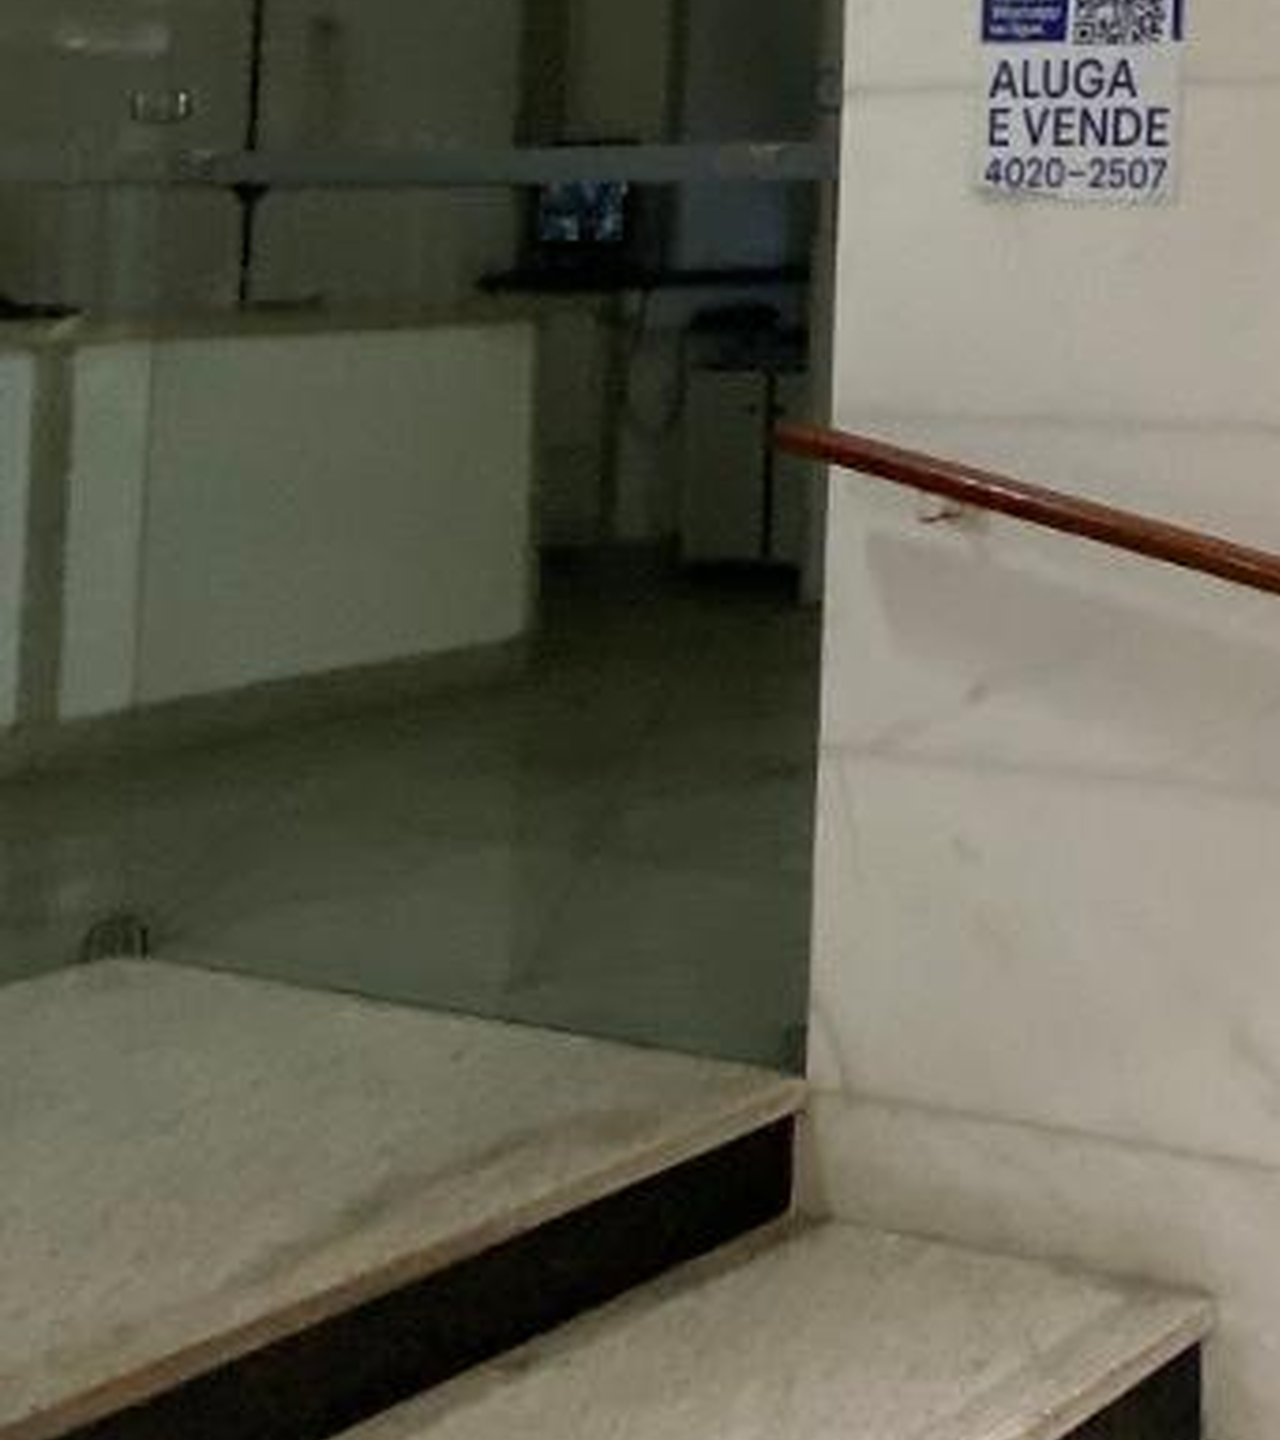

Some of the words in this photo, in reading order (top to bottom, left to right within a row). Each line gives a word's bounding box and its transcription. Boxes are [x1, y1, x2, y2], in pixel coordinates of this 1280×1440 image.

[989, 59, 1137, 99] ALUGA
[989, 107, 1011, 147] E
[1023, 107, 1170, 147] VENDE
[985, 157, 1168, 189] 4020-2507
